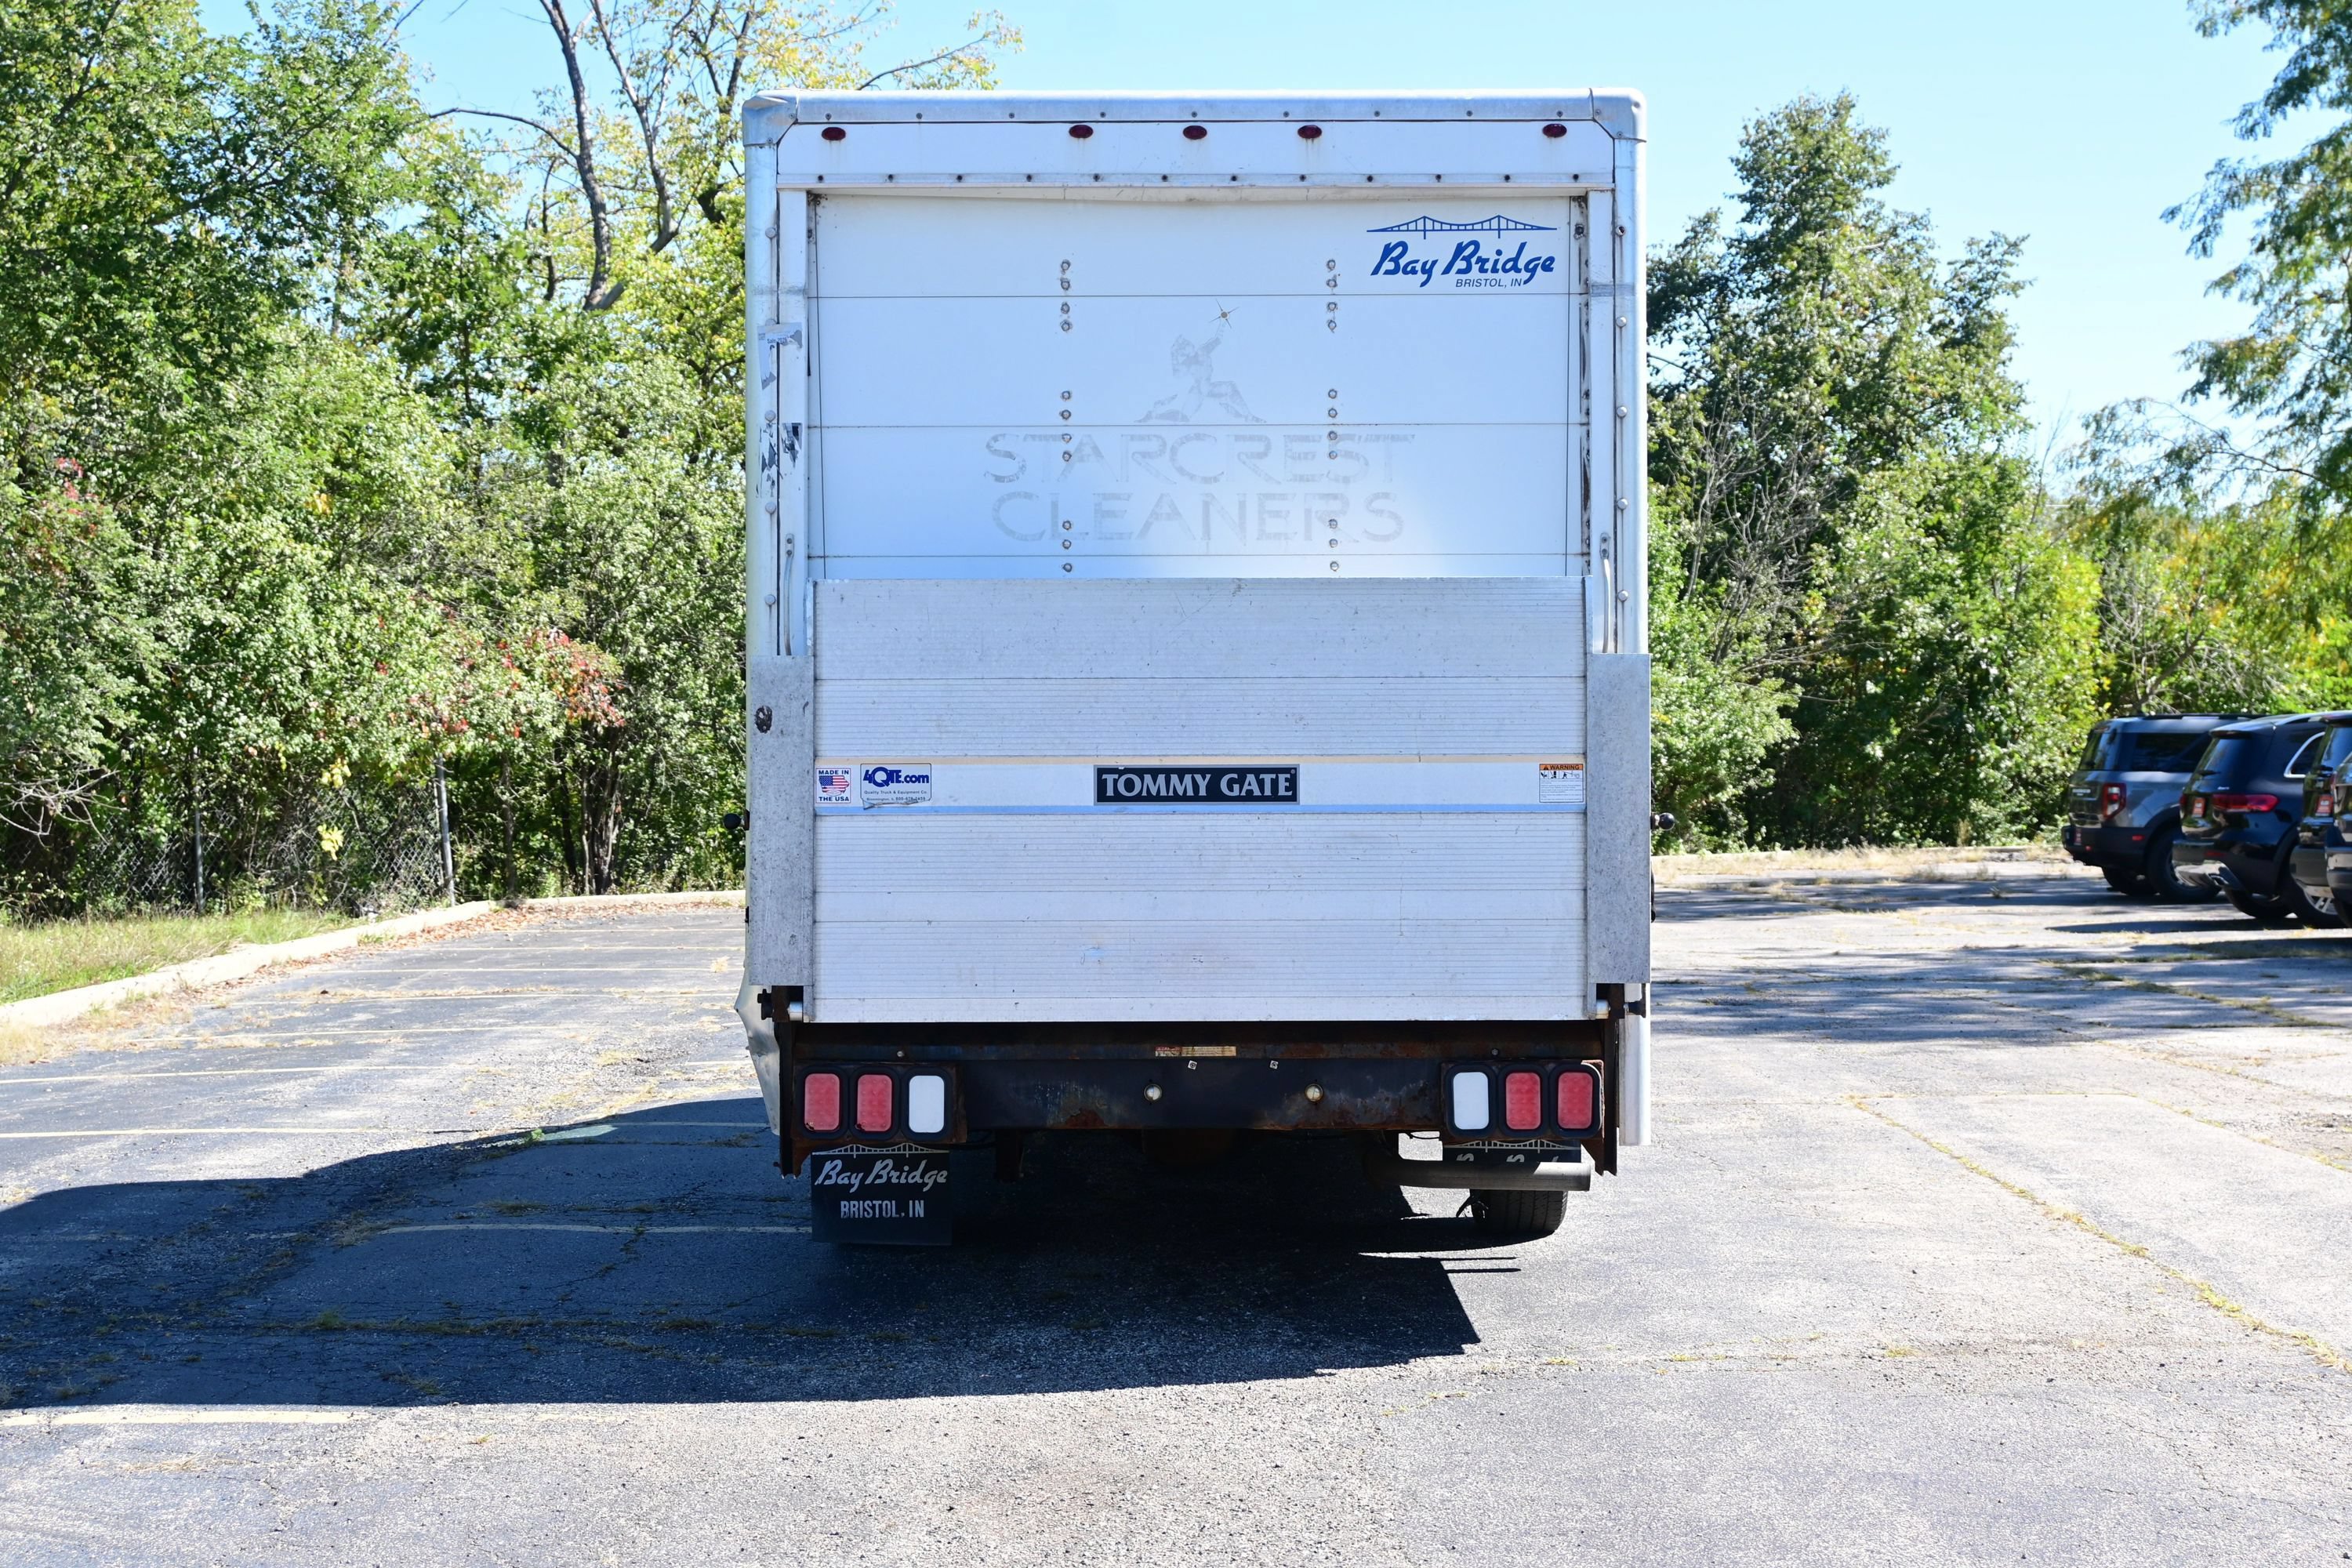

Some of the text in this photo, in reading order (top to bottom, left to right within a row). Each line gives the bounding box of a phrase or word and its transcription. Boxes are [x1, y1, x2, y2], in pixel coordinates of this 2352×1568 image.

[1370, 240, 1555, 288] Bay Bridge
[1455, 278, 1523, 289] BRISTOL, IN
[983, 433, 1416, 485] STARCREST
[991, 491, 1405, 543] CLEANERS
[1102, 773, 1292, 797] TOMMY GATE
[815, 1159, 948, 1193] Bay Bridge
[909, 1200, 924, 1218] IN
